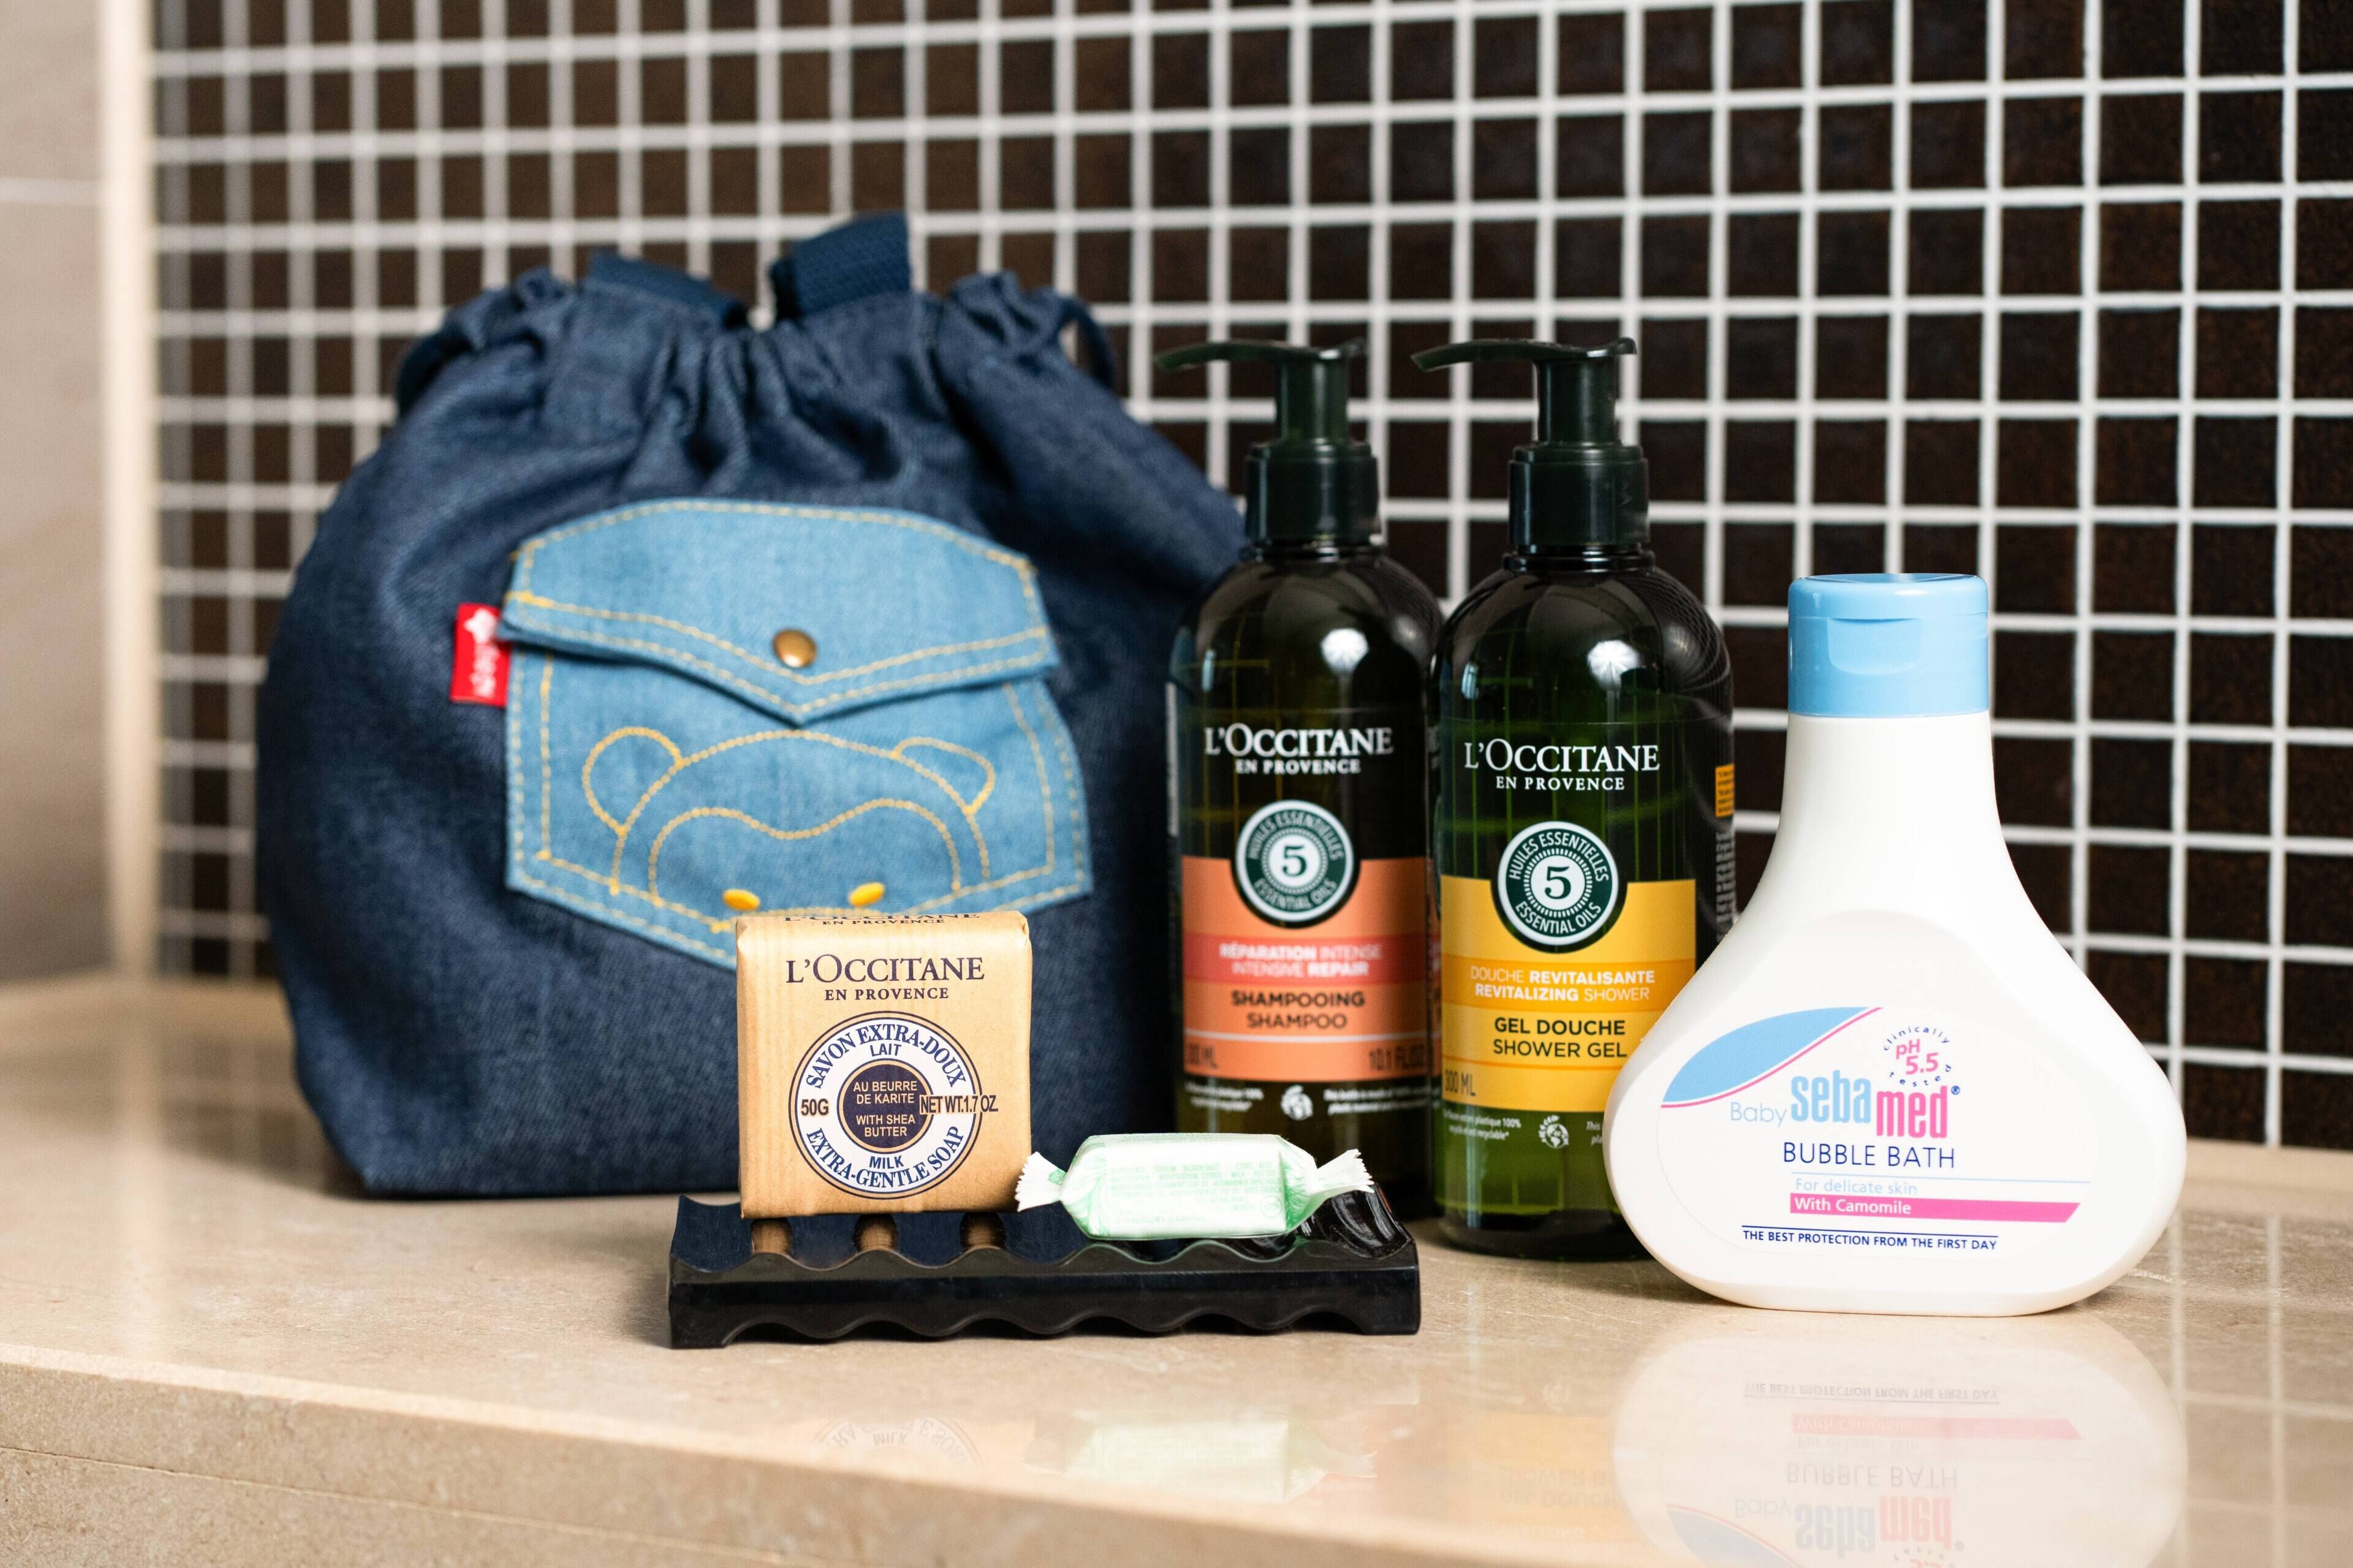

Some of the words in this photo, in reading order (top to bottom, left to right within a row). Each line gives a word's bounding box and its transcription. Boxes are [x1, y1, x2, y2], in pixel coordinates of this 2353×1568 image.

[1204, 722, 1393, 757] L'OCCITANE
[1464, 738, 1660, 773] L'OCCITANE
[1235, 759, 1257, 774] EN
[1264, 759, 1361, 775] PROVENCE
[1496, 776, 1517, 790] EN
[1525, 776, 1625, 791] PROVENCE
[1283, 844, 1307, 877] 5
[1509, 838, 1539, 880] HUILES
[1539, 831, 1609, 882] ESSENTIELLES
[1544, 866, 1571, 900] 5
[1515, 901, 1576, 934] ESSENTIAL
[1575, 901, 1601, 928] OILS
[786, 954, 985, 983] L'OCCITANE
[1471, 965, 1524, 982] DOUCHE
[1529, 970, 1655, 985] REVITALISANTE
[825, 989, 849, 1001] EN
[855, 988, 949, 1000] PROVENCE
[1231, 990, 1365, 1007] SHAMPOOING
[1475, 983, 1578, 1001] REVITALIZING
[1584, 987, 1650, 1002] SHOWER
[1247, 1012, 1347, 1029] SHAMPOO
[1495, 1017, 1530, 1034] GEL
[1537, 1019, 1626, 1036] DOUCHE
[1884, 1026, 1950, 1051] clinically
[806, 1032, 856, 1088] SAVON
[855, 1024, 966, 1088] EXTRA-DOUX
[870, 1043, 902, 1056] LAIT
[1493, 1039, 1580, 1058] SHOWER
[1587, 1042, 1627, 1058] GEL
[1896, 1039, 1920, 1059] pH
[1906, 1052, 1939, 1075] 5.5
[1890, 1064, 1952, 1087] tested
[853, 1081, 868, 1092] AU
[872, 1081, 917, 1091] BEURRE
[801, 1099, 829, 1116] 50G
[857, 1094, 871, 1104] DE
[874, 1093, 914, 1104] KARITE
[920, 1096, 942, 1113] NET
[980, 1095, 998, 1112] OZ.
[856, 1115, 882, 1125] WITH
[886, 1115, 915, 1124] SHEA
[1730, 1102, 1787, 1127] Baby
[864, 1126, 907, 1137] BUTTER
[807, 1128, 930, 1188] EXTRA-GENTLE
[927, 1126, 963, 1170] SOAP
[869, 1156, 904, 1168] MILK
[1784, 1142, 1875, 1165] BUBBLE
[1888, 1146, 1955, 1168] BATH
[1795, 1178, 1819, 1192] For
[1824, 1180, 1883, 1194] delicate
[1887, 1183, 1918, 1195] skin
[1794, 1197, 1831, 1212] With
[1836, 1199, 1912, 1215] Camomile
[1743, 1230, 1764, 1241] THE
[1768, 1231, 1795, 1243] BEST
[1798, 1233, 1870, 1246] PROTECTION
[1874, 1236, 1908, 1248] FROM
[1911, 1238, 1934, 1248] THE
[1938, 1239, 1968, 1249] FIRST
[1971, 1240, 1997, 1250] DAY
